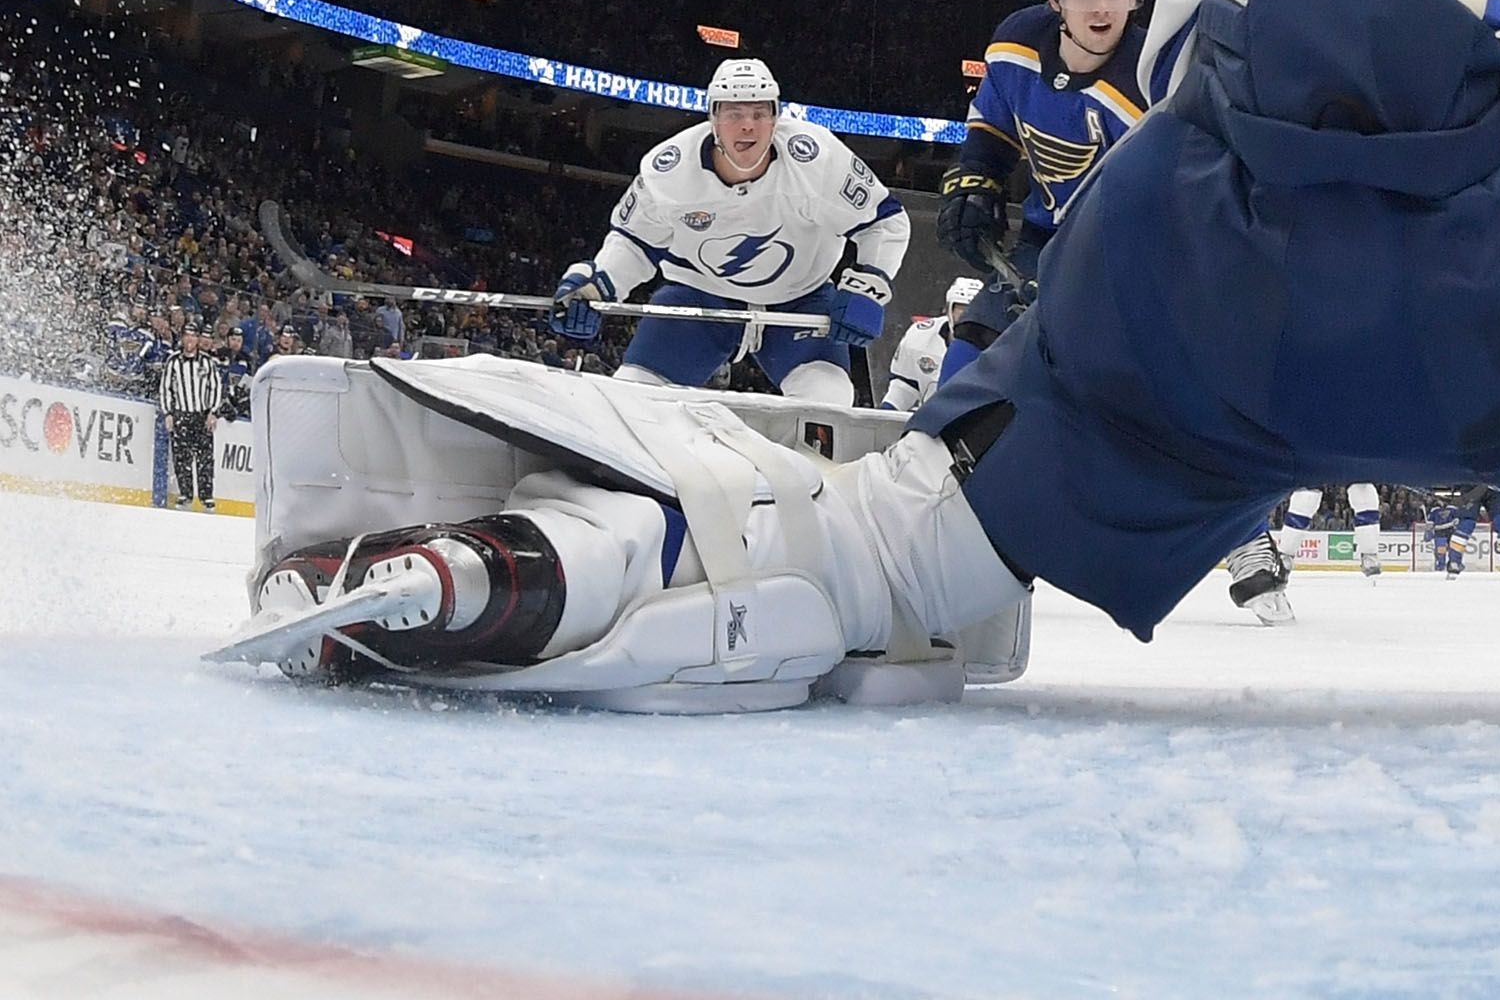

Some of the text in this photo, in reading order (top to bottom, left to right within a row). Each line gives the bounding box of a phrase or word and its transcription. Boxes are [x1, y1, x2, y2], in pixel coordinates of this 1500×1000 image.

[566, 65, 709, 113] HAPPY HOLI
[839, 154, 877, 211] 59
[411, 286, 506, 307] CCM
[221, 442, 253, 473] MOL
